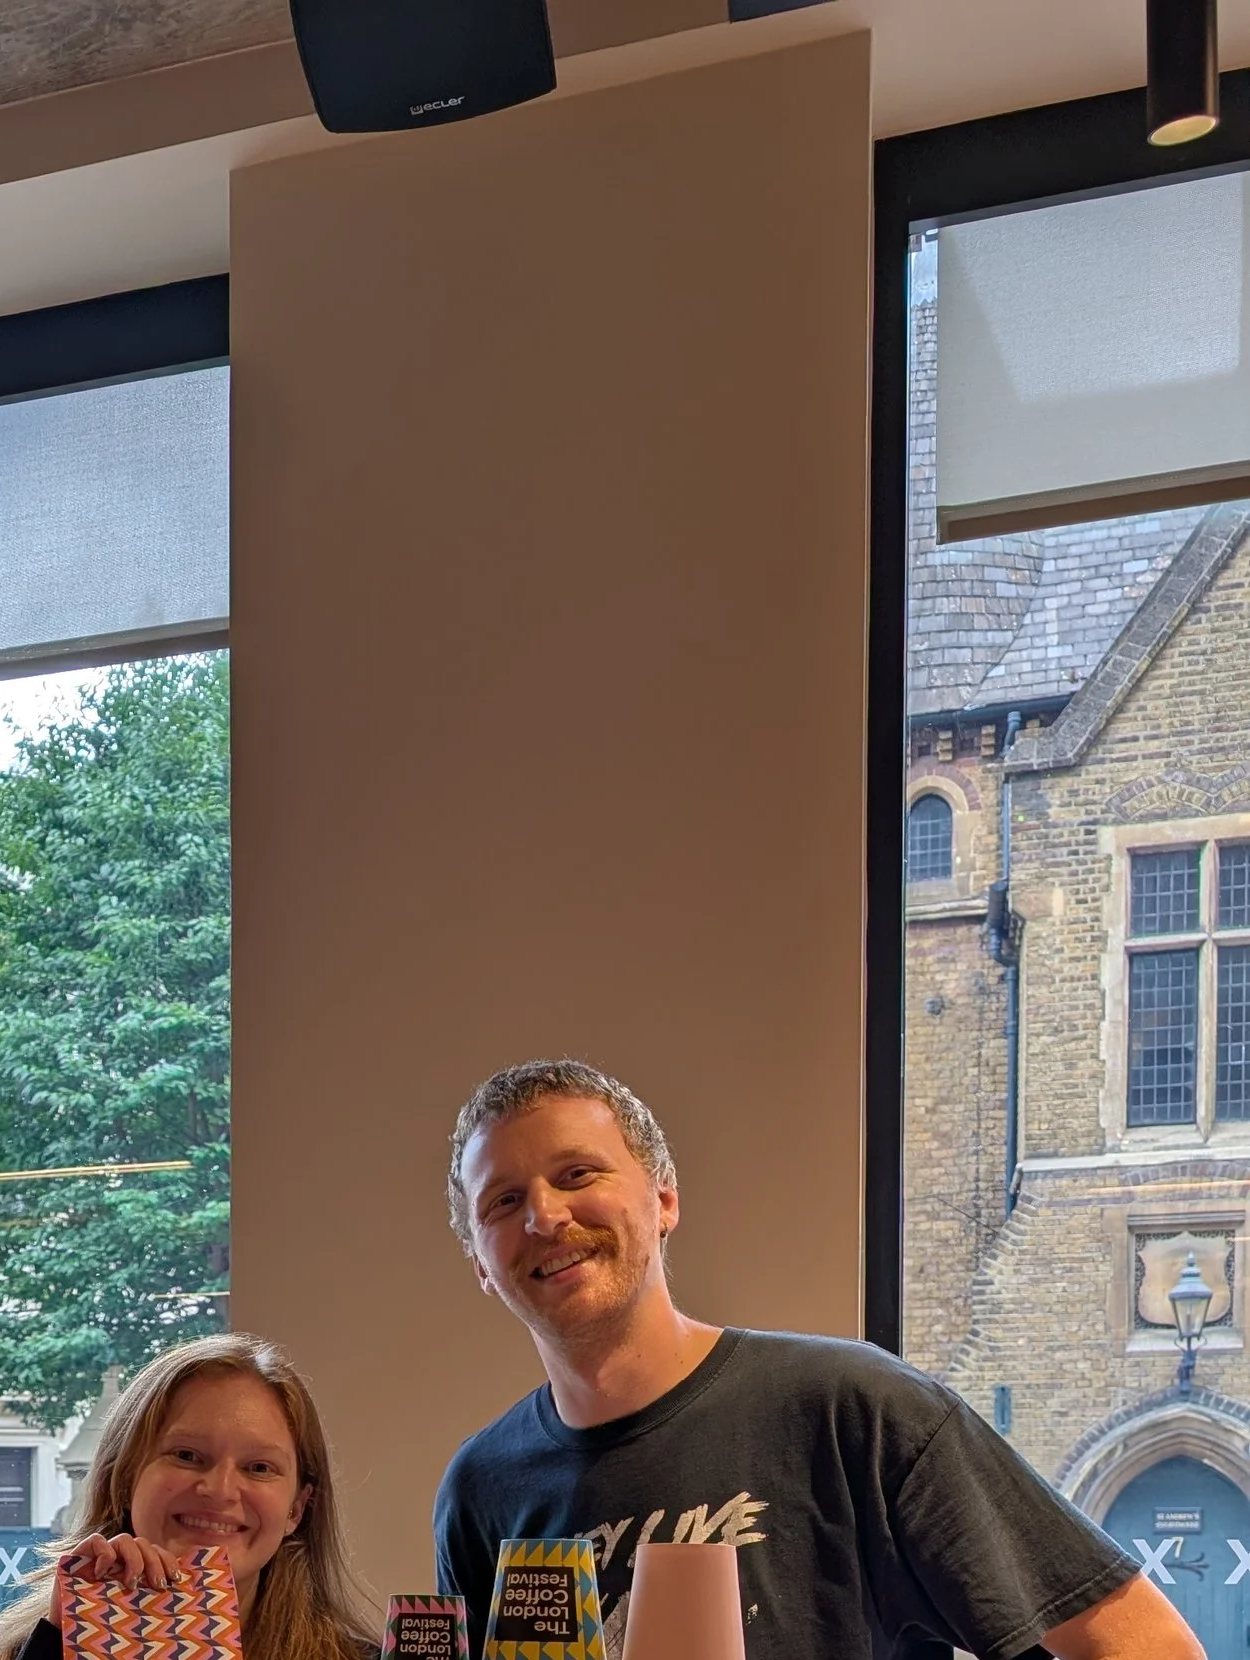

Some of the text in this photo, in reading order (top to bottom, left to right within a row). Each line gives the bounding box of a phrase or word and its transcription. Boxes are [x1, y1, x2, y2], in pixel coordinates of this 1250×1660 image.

[507, 1573, 568, 1588] Festival
[505, 1588, 569, 1605] Coffee
[503, 1605, 569, 1620] London
[401, 1618, 450, 1629] Festival
[534, 1621, 570, 1635] The
[401, 1630, 451, 1643] Coffee
[400, 1644, 451, 1656] London
